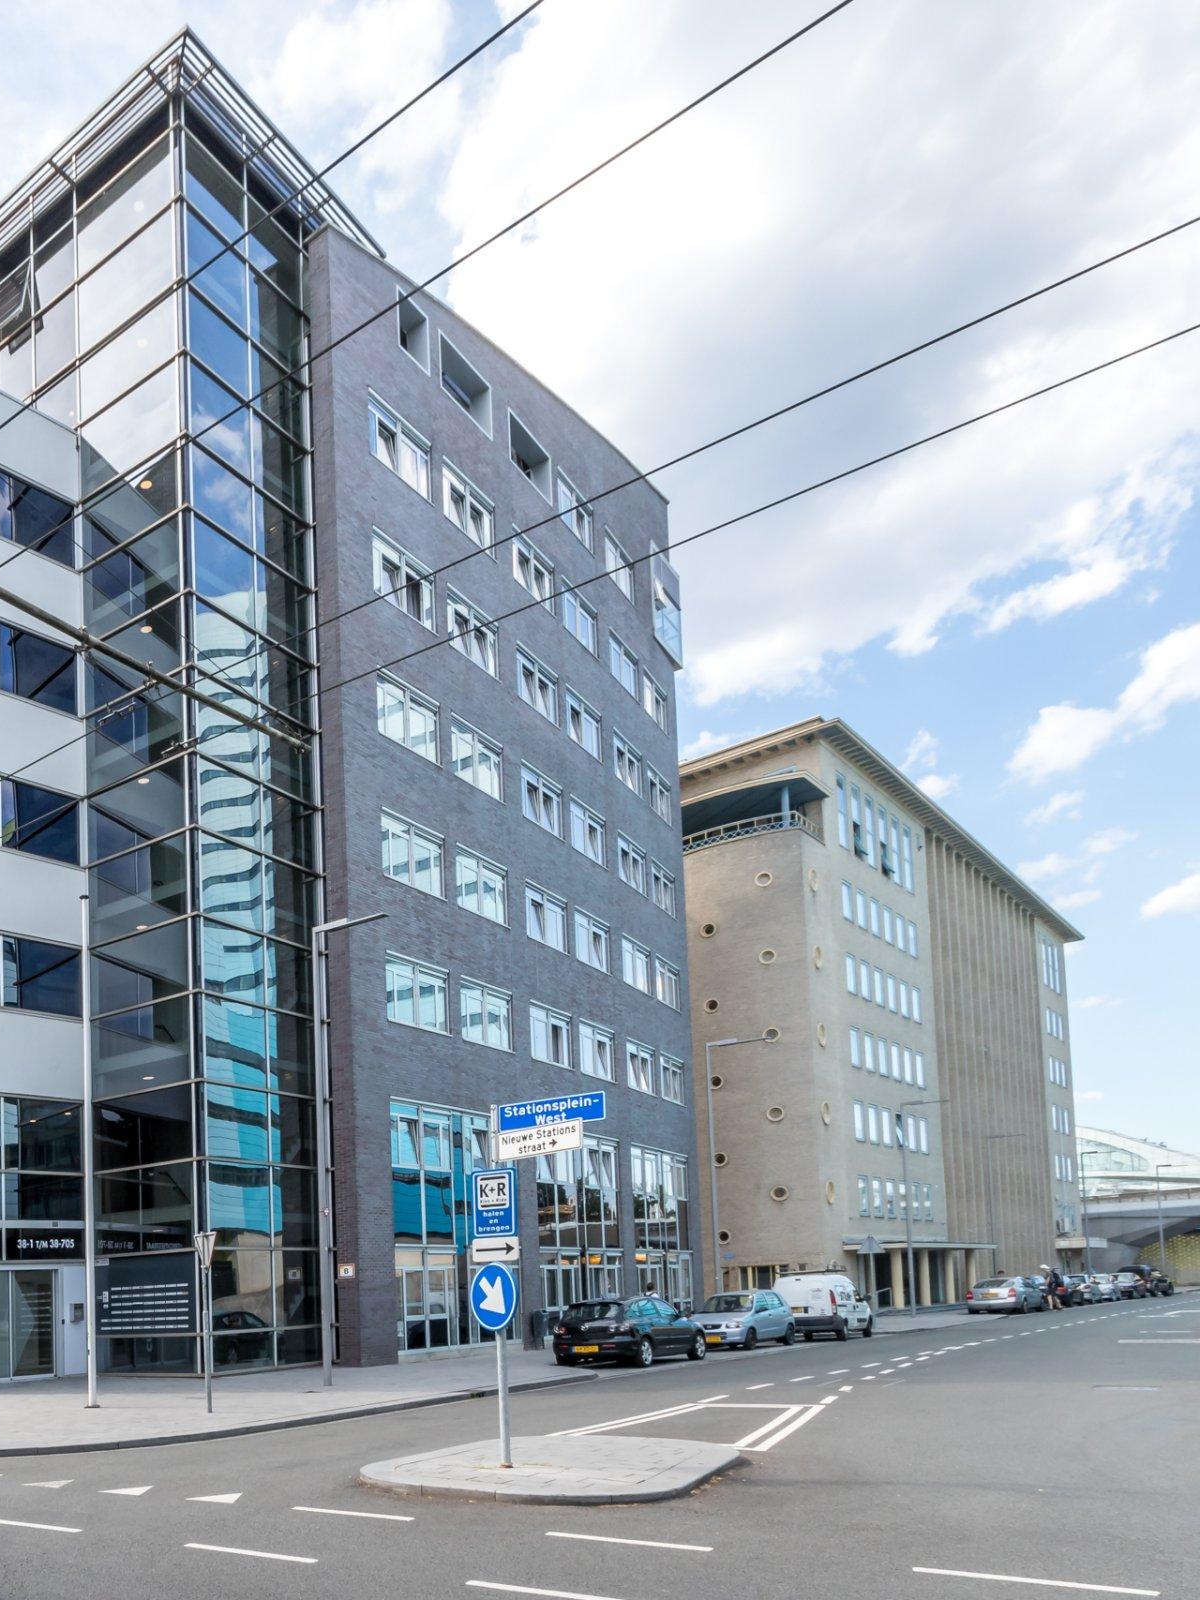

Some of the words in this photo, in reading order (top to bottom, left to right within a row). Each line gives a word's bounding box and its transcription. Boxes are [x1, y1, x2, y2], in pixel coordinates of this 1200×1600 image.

[504, 1097, 599, 1117] Stationsplein-
[535, 1112, 567, 1126] West
[501, 1132, 534, 1146] Nieuwe
[536, 1124, 576, 1139] Stations
[518, 1141, 547, 1154] straat
[480, 1182, 506, 1198] K+R
[17, 1239, 34, 1249] 38-1
[36, 1240, 48, 1250] T/M
[49, 1239, 75, 1248] 38-705
